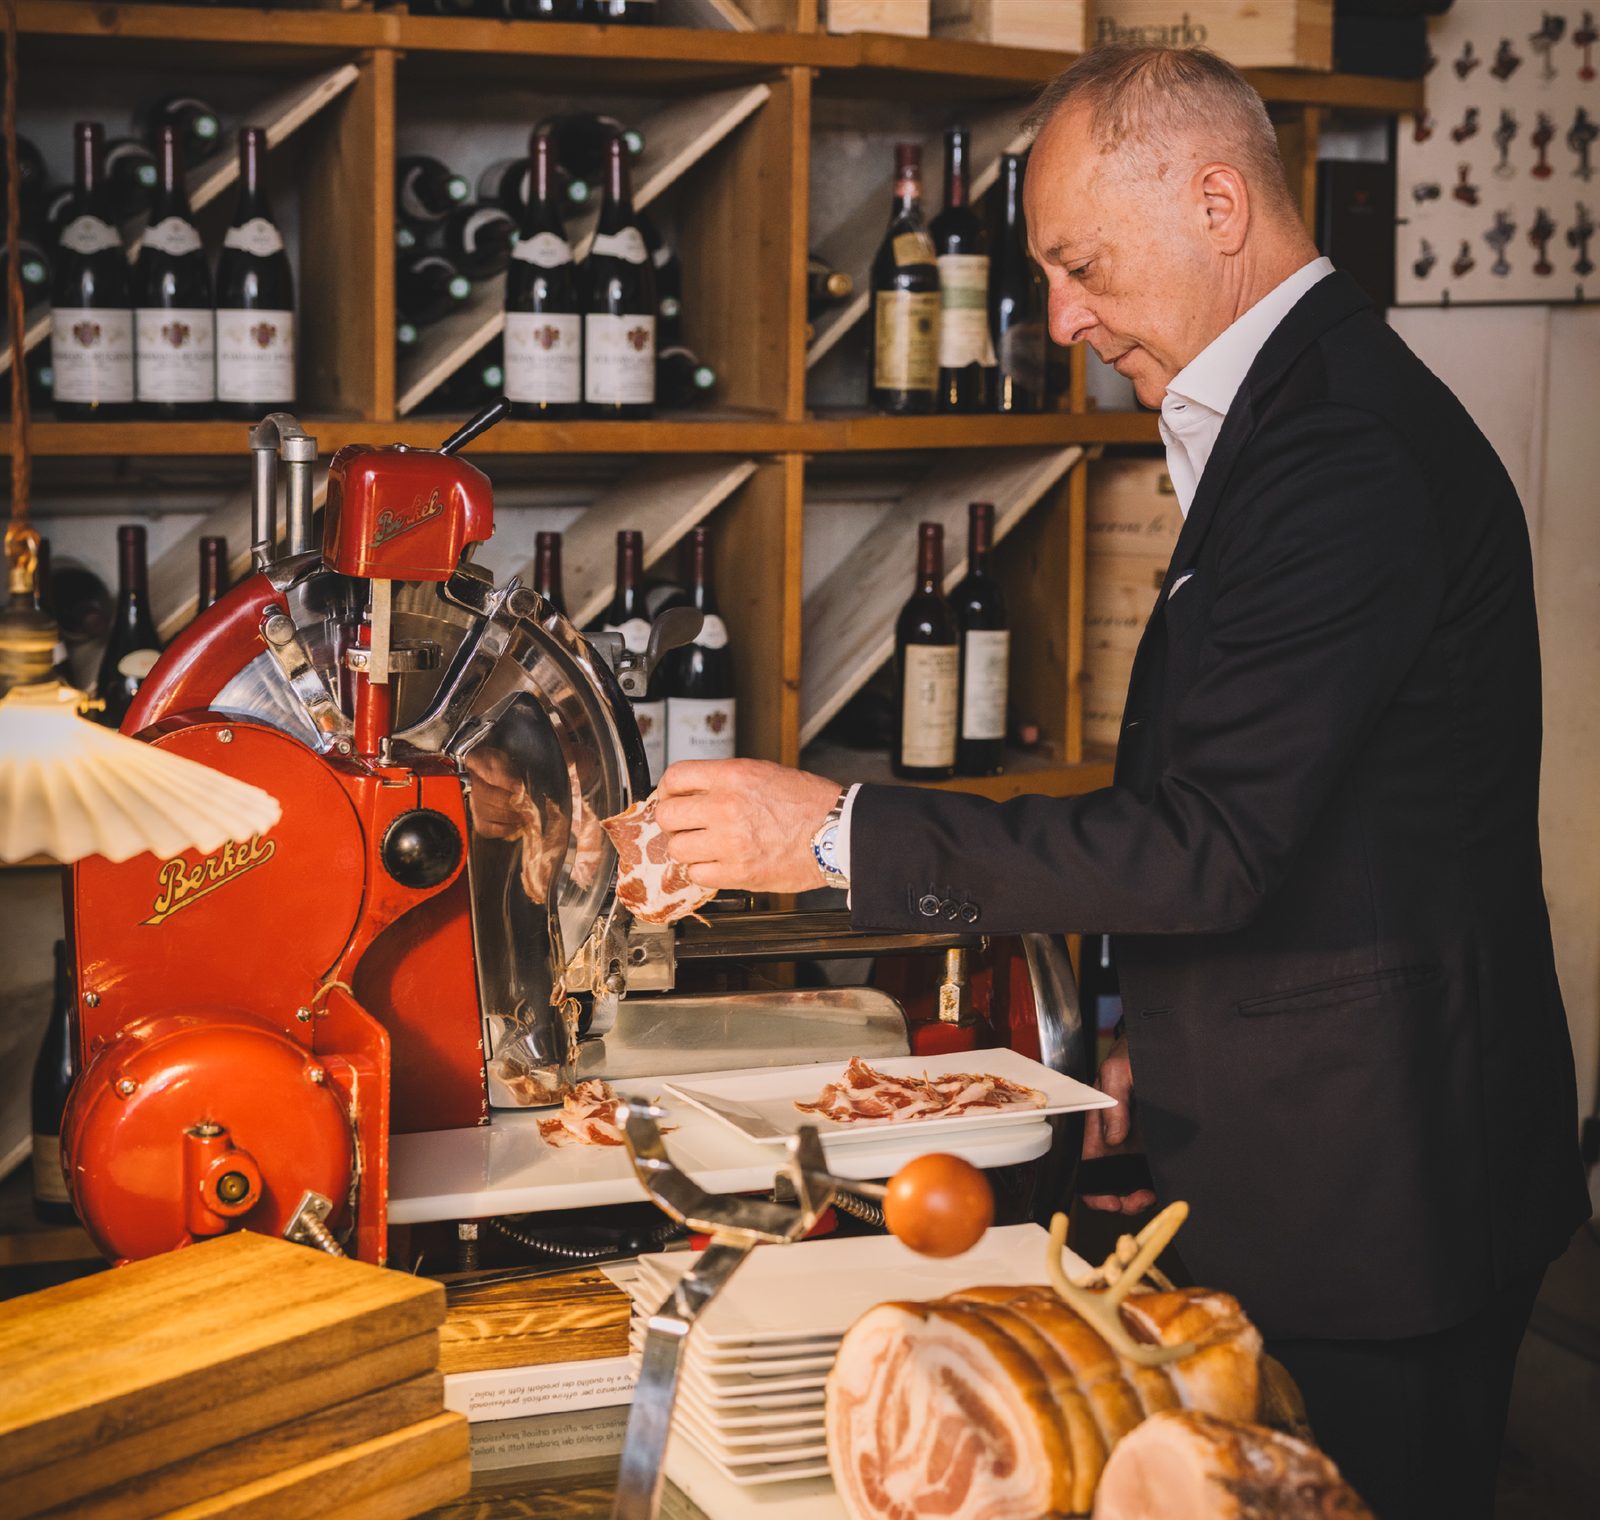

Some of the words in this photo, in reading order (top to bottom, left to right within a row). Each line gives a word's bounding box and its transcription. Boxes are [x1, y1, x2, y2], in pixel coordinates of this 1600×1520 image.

[1096, 12, 1208, 49] Percarlo
[139, 832, 276, 925] Berkel
[508, 1386, 525, 1395] fatti
[528, 1383, 560, 1392] prodotti
[581, 1388, 594, 1396] per
[596, 1383, 636, 1395] sperienza
[522, 1394, 551, 1405] articoli
[552, 1390, 578, 1400] offrire
[469, 1397, 520, 1411] professionali
